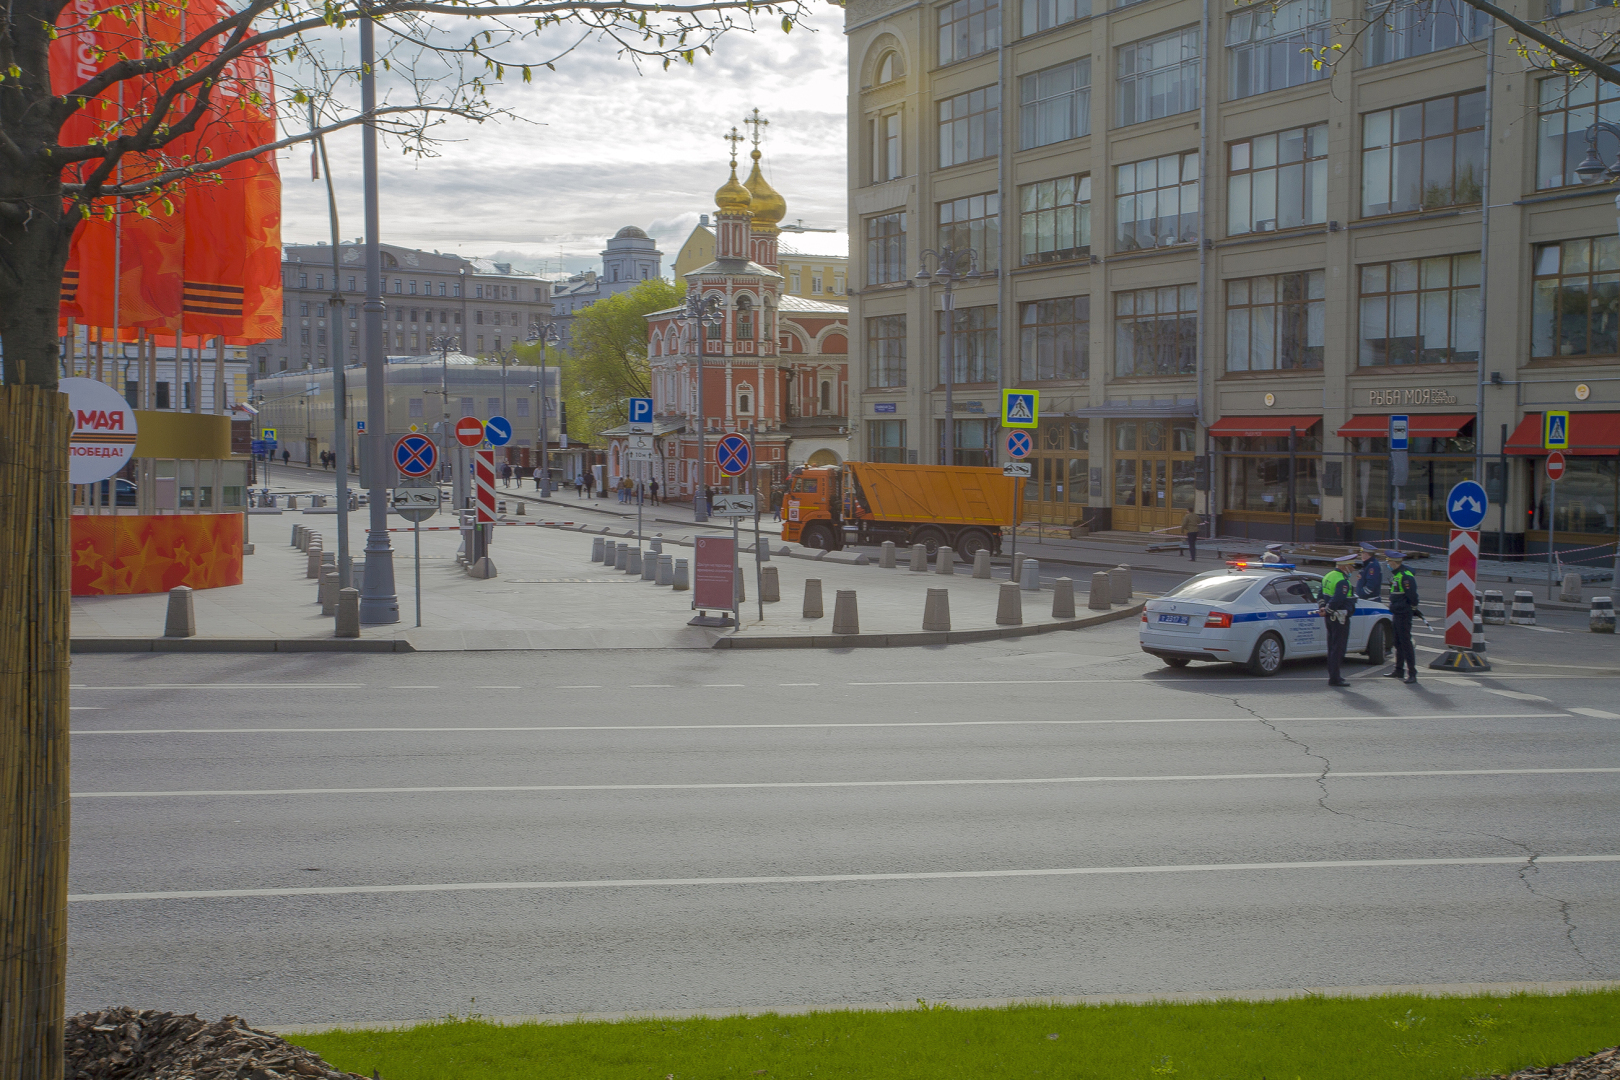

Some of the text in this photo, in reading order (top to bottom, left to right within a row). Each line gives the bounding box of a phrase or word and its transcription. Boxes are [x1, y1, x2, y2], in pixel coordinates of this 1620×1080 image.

[1369, 388, 1430, 405] РЫБА МОЯ
[77, 409, 124, 430] МАЯ
[69, 447, 123, 458] ПОБЕДА!
